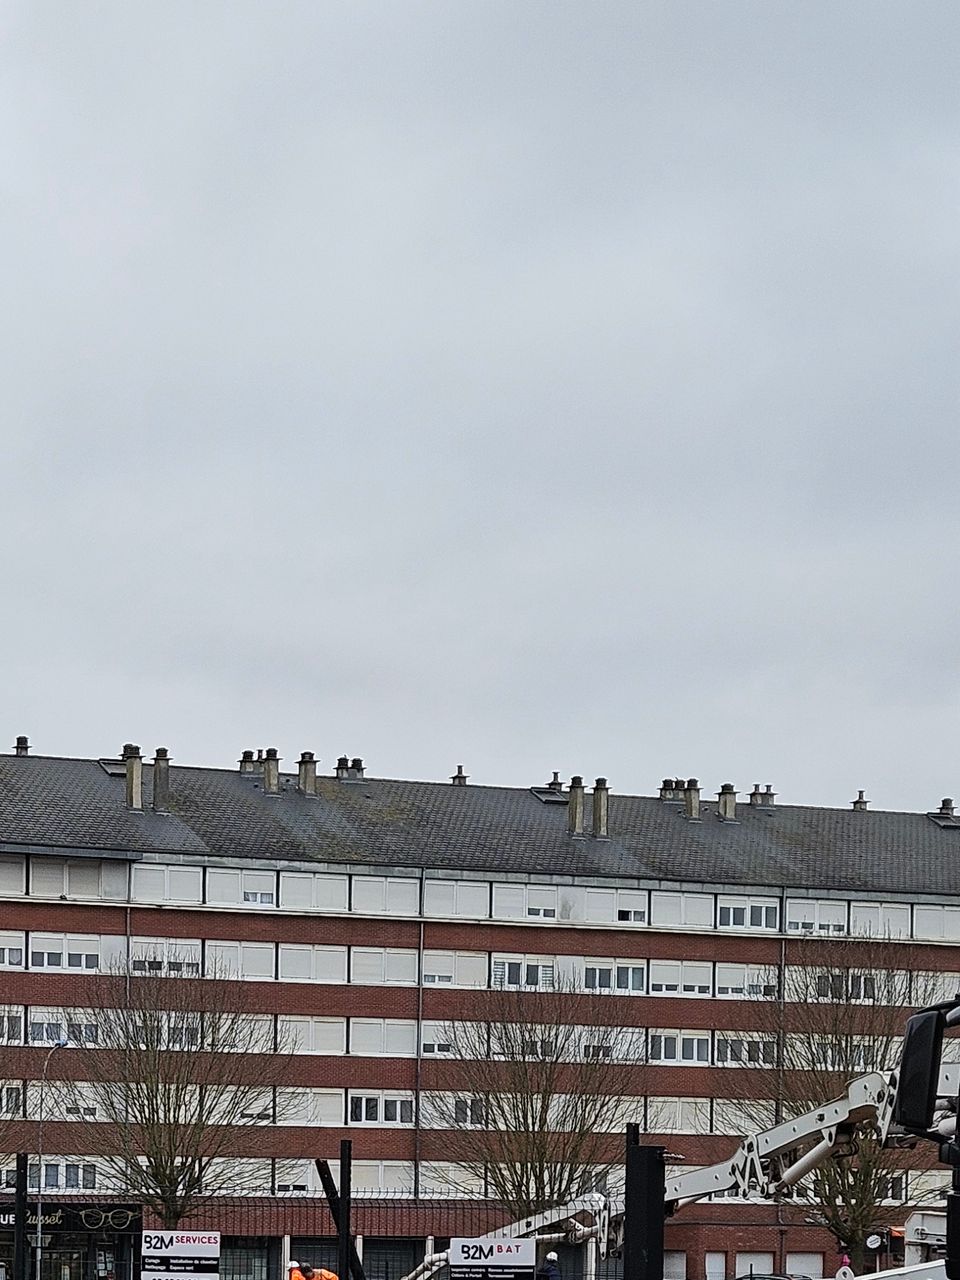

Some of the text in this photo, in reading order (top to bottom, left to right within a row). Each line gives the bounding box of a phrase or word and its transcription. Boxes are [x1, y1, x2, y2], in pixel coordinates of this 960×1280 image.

[144, 1235, 218, 1249] B2M SERVICES
[461, 1245, 494, 1260] B2M
